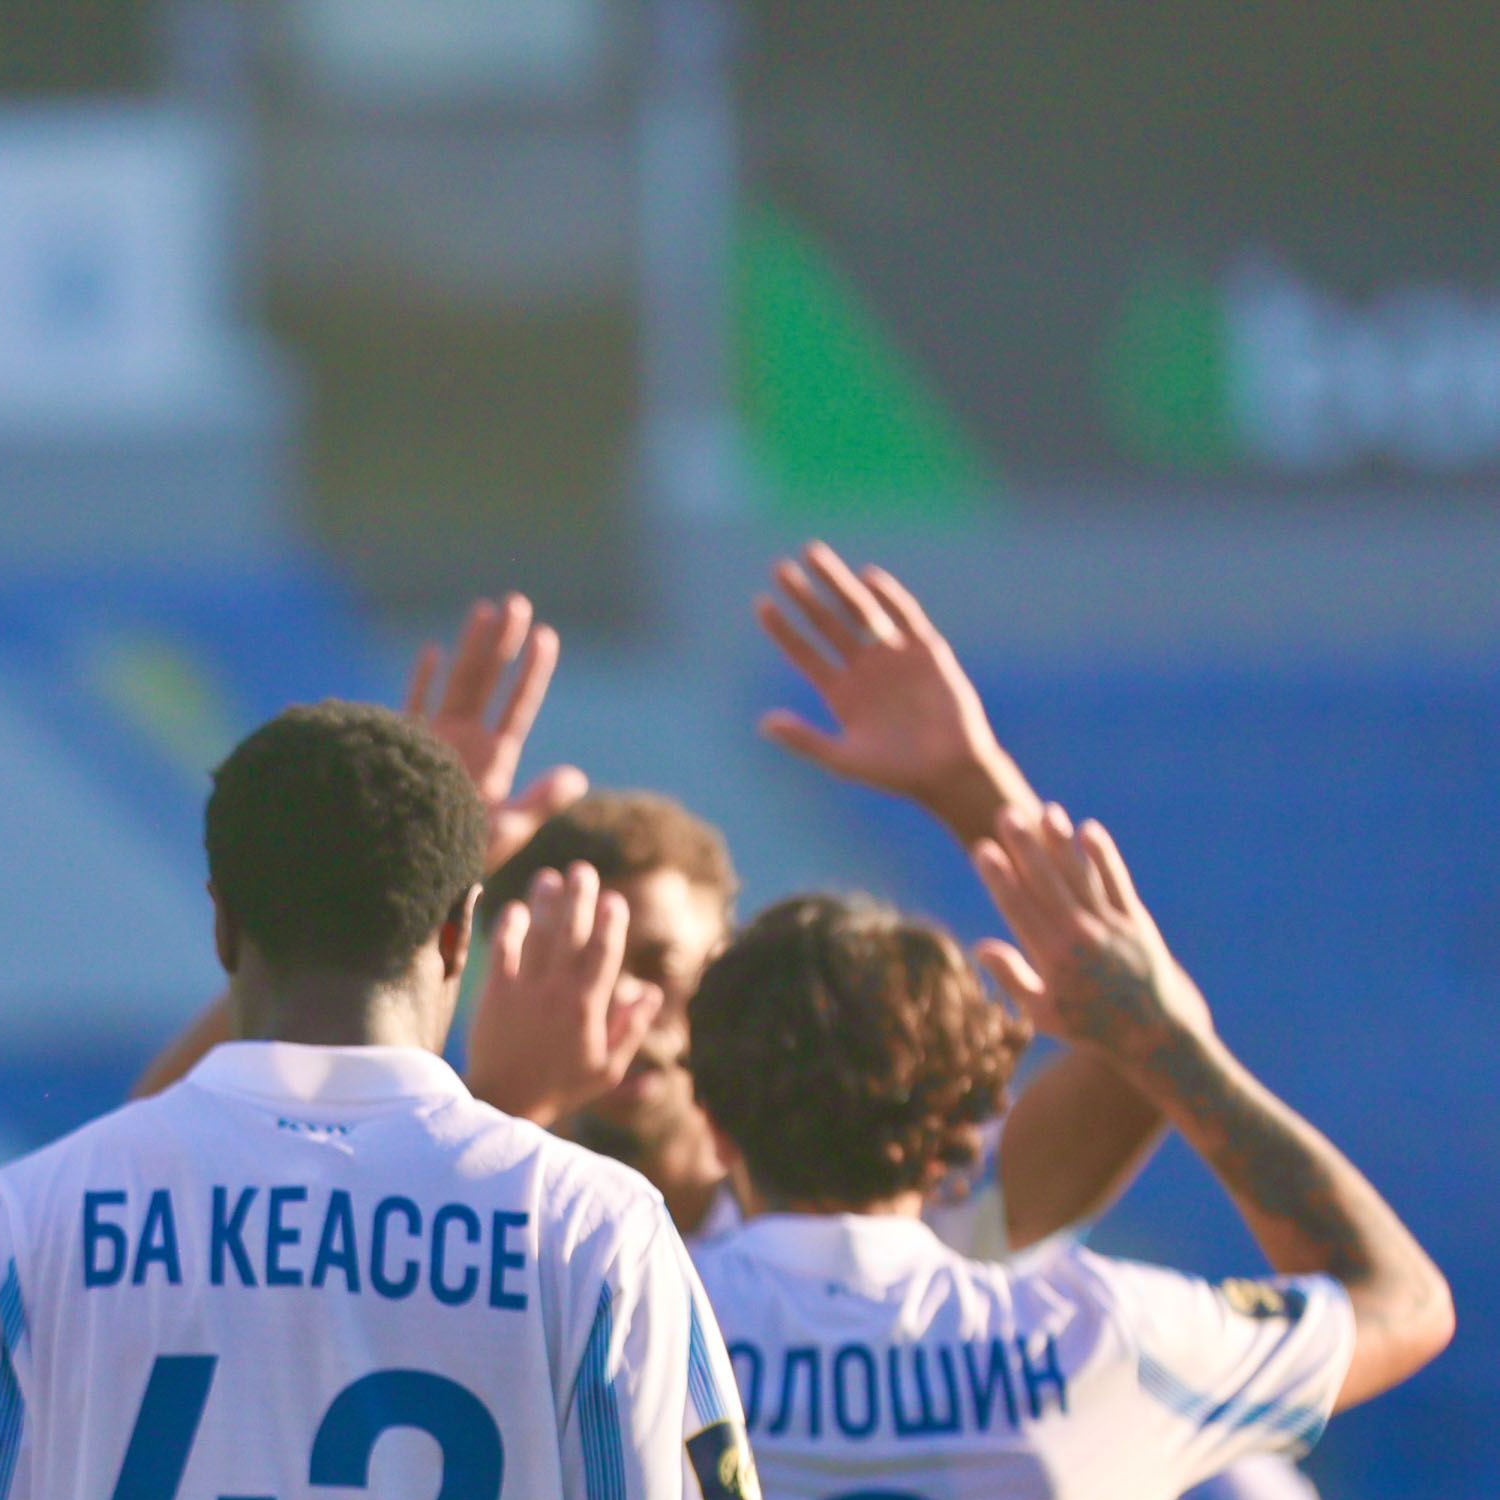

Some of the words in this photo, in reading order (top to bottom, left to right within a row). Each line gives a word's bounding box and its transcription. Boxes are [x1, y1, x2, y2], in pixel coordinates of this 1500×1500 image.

[83, 1188, 182, 1290] БА
[210, 1185, 530, 1312] КЕАССЕ
[728, 1333, 1068, 1440] ОЛОШИН
